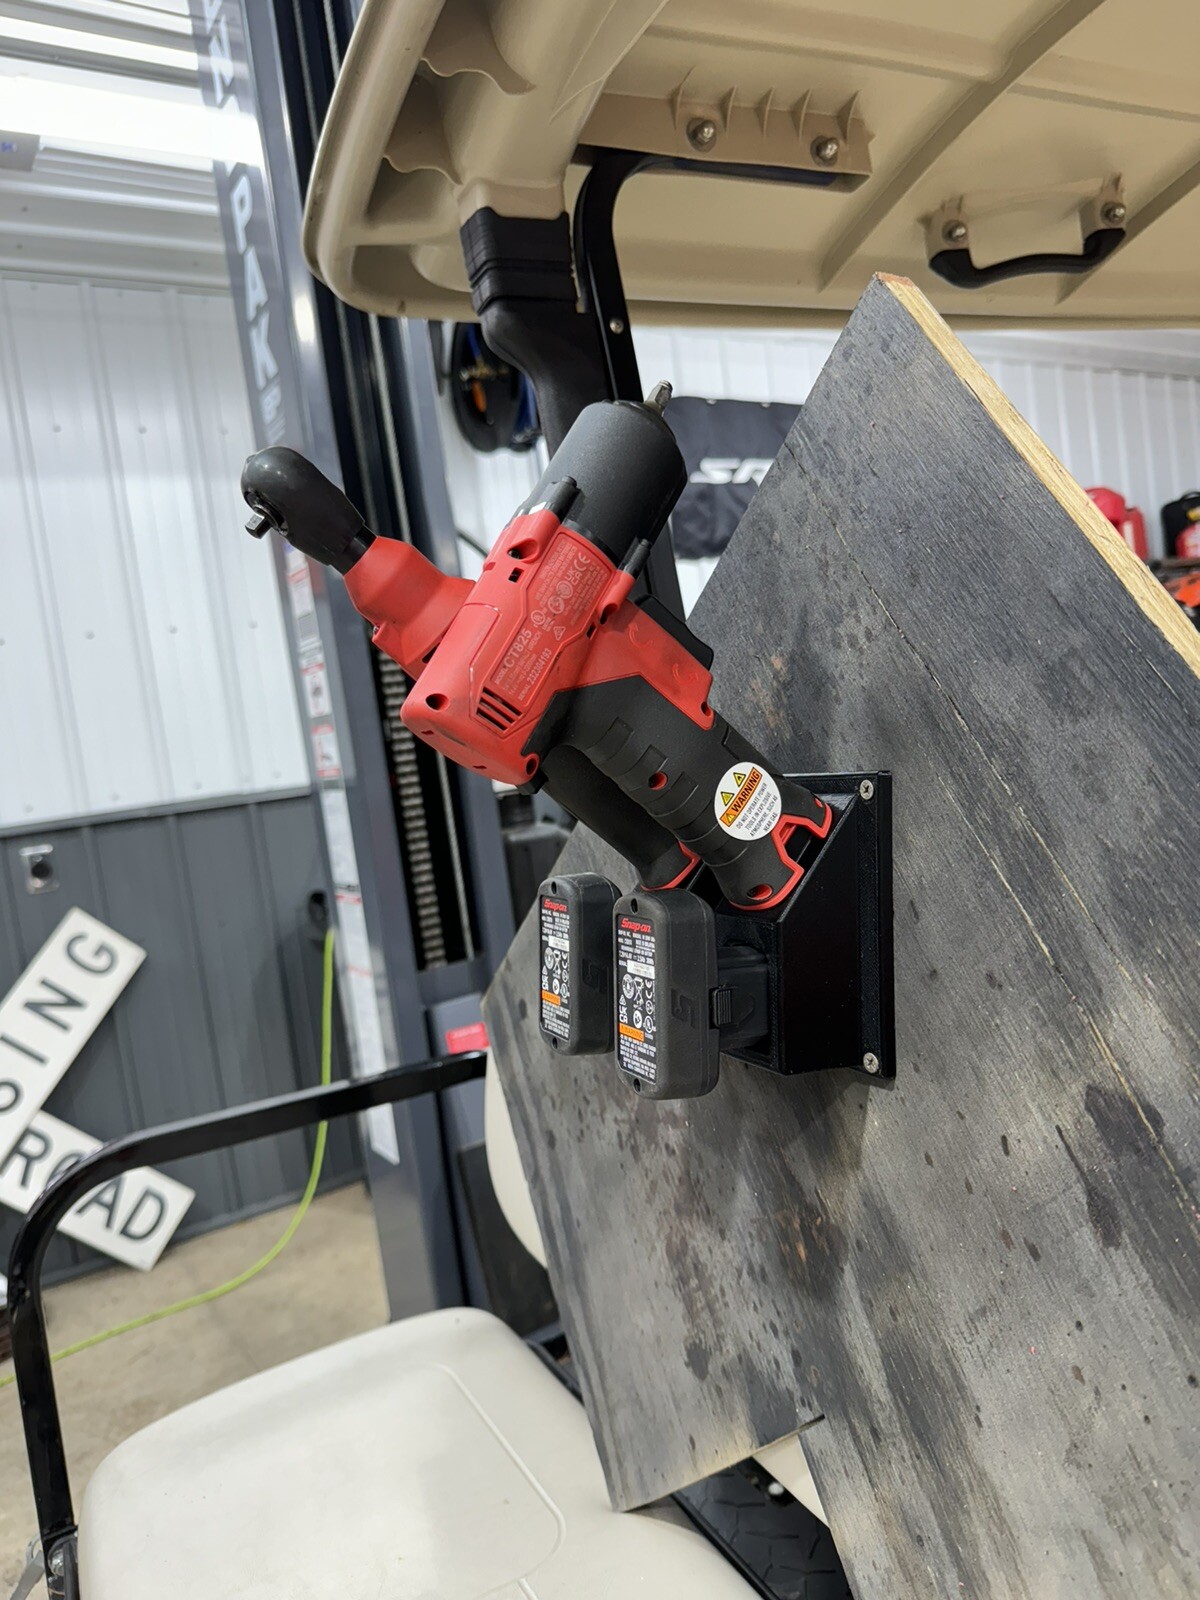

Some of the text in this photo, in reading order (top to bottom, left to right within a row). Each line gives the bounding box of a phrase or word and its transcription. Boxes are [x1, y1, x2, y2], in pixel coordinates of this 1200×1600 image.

[495, 667, 508, 685] MODEL
[503, 628, 532, 668] CT825
[732, 771, 760, 812] WARNING
[544, 899, 567, 912] Snap-on
[621, 918, 651, 932] Snap-on
